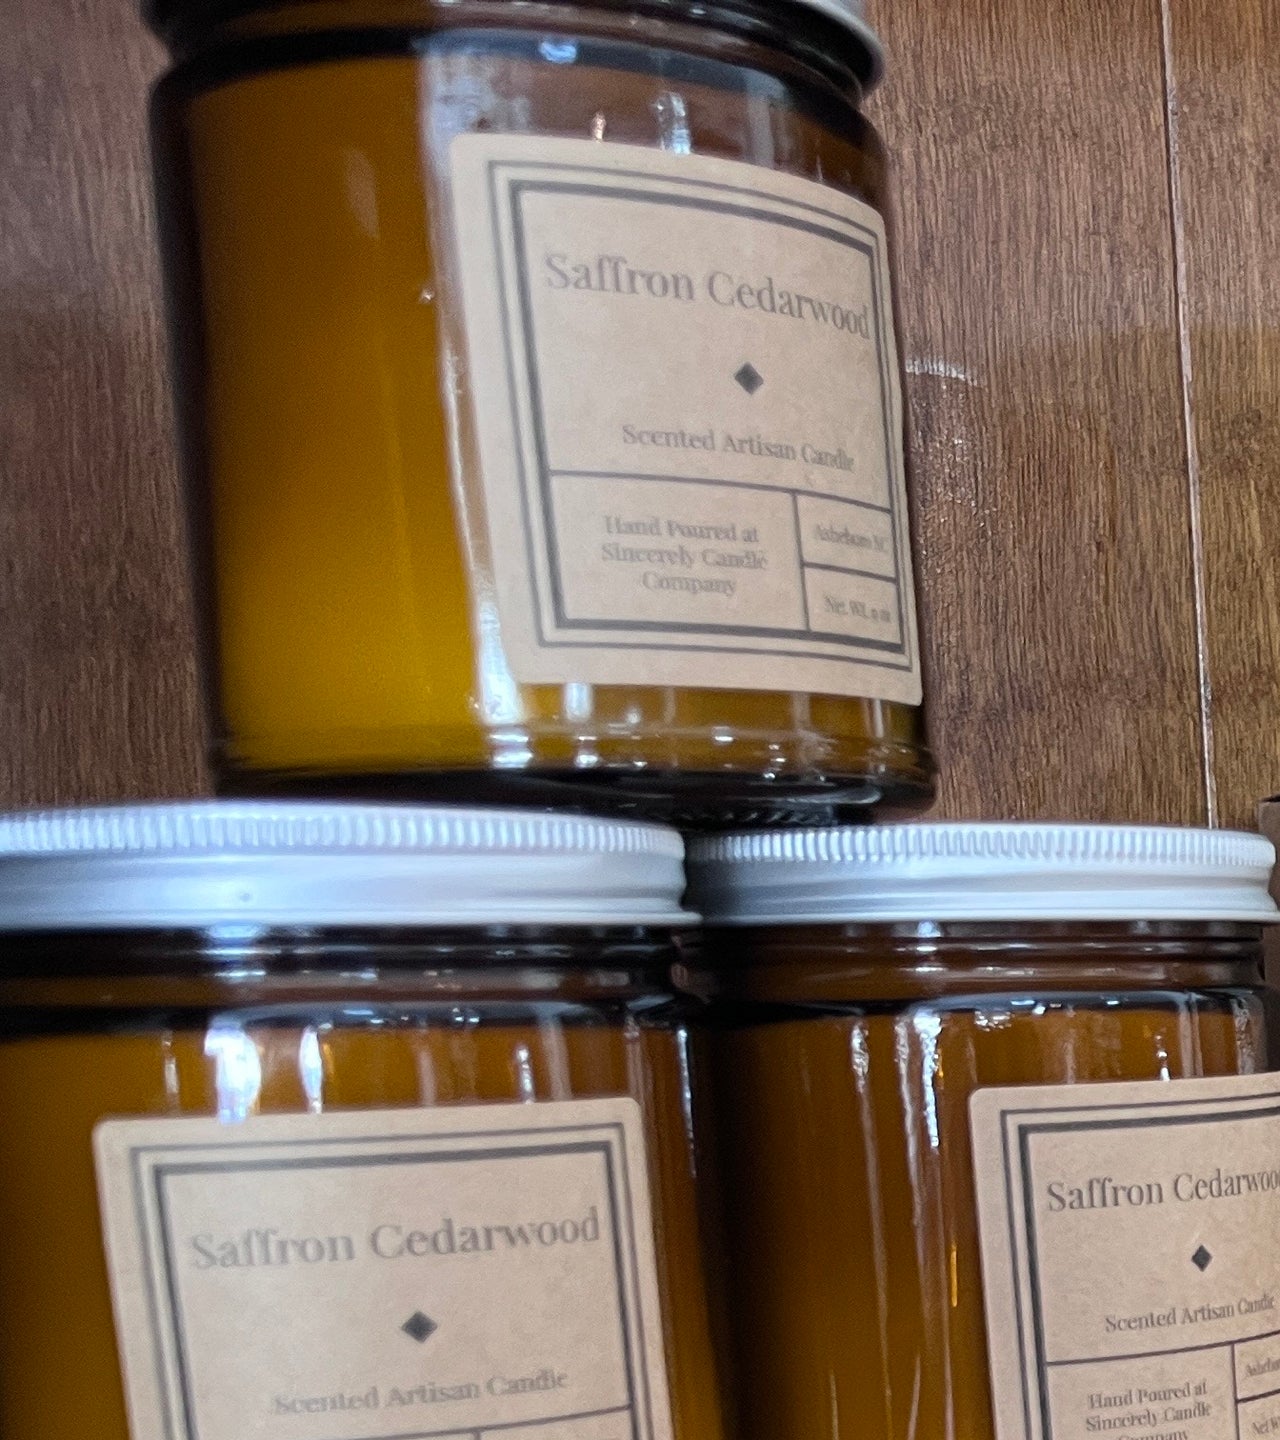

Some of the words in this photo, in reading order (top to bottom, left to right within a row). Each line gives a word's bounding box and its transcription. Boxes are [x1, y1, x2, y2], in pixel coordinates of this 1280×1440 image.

[544, 252, 695, 300] Saffron
[707, 269, 872, 340] Cedarwood
[622, 423, 716, 452] Scented
[722, 433, 797, 461] Artisan
[801, 443, 855, 473] Candle
[606, 515, 662, 536] Hand
[667, 519, 737, 541] Poured
[743, 524, 759, 543] at
[602, 543, 695, 568] Sincerely
[702, 548, 768, 570] Candle
[642, 571, 737, 597] Company
[1047, 1174, 1164, 1211] Saffron
[187, 1226, 355, 1271] Saffron
[369, 1206, 602, 1261] Cedarwood
[1105, 1307, 1177, 1332] Scented
[1181, 1303, 1235, 1325] Artisan
[1238, 1294, 1275, 1316] Candle
[271, 1386, 380, 1418] Scented
[385, 1376, 480, 1410] Artisan
[486, 1367, 568, 1400] Candle
[1087, 1389, 1133, 1409] Hand
[1138, 1382, 1191, 1404] Poured
[1194, 1378, 1208, 1397] at
[1085, 1409, 1158, 1433] Sincerely
[1163, 1401, 1211, 1423] Candle
